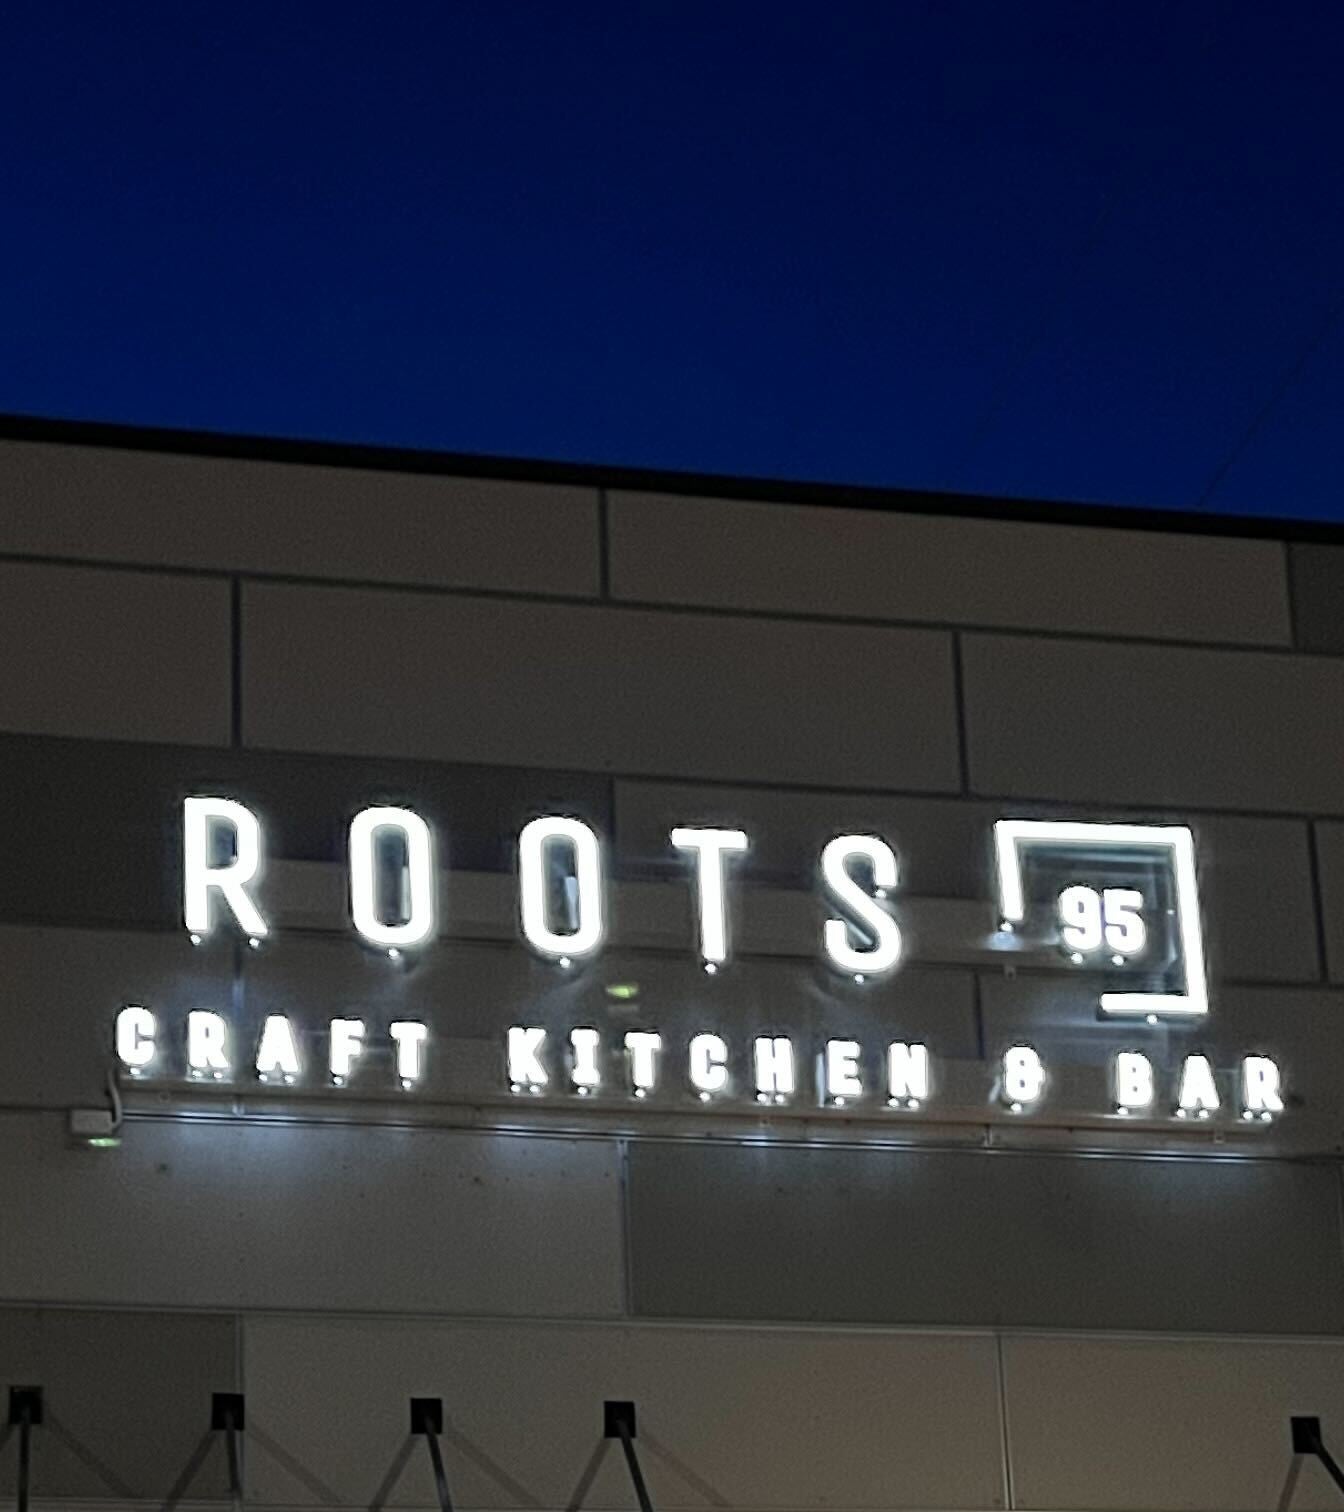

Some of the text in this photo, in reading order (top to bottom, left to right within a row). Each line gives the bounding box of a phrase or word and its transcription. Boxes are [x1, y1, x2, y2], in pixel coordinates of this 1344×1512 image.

[182, 796, 1146, 975] ROOTS 95
[115, 1005, 1286, 1112] CRAFT KITCHEN & BAR
